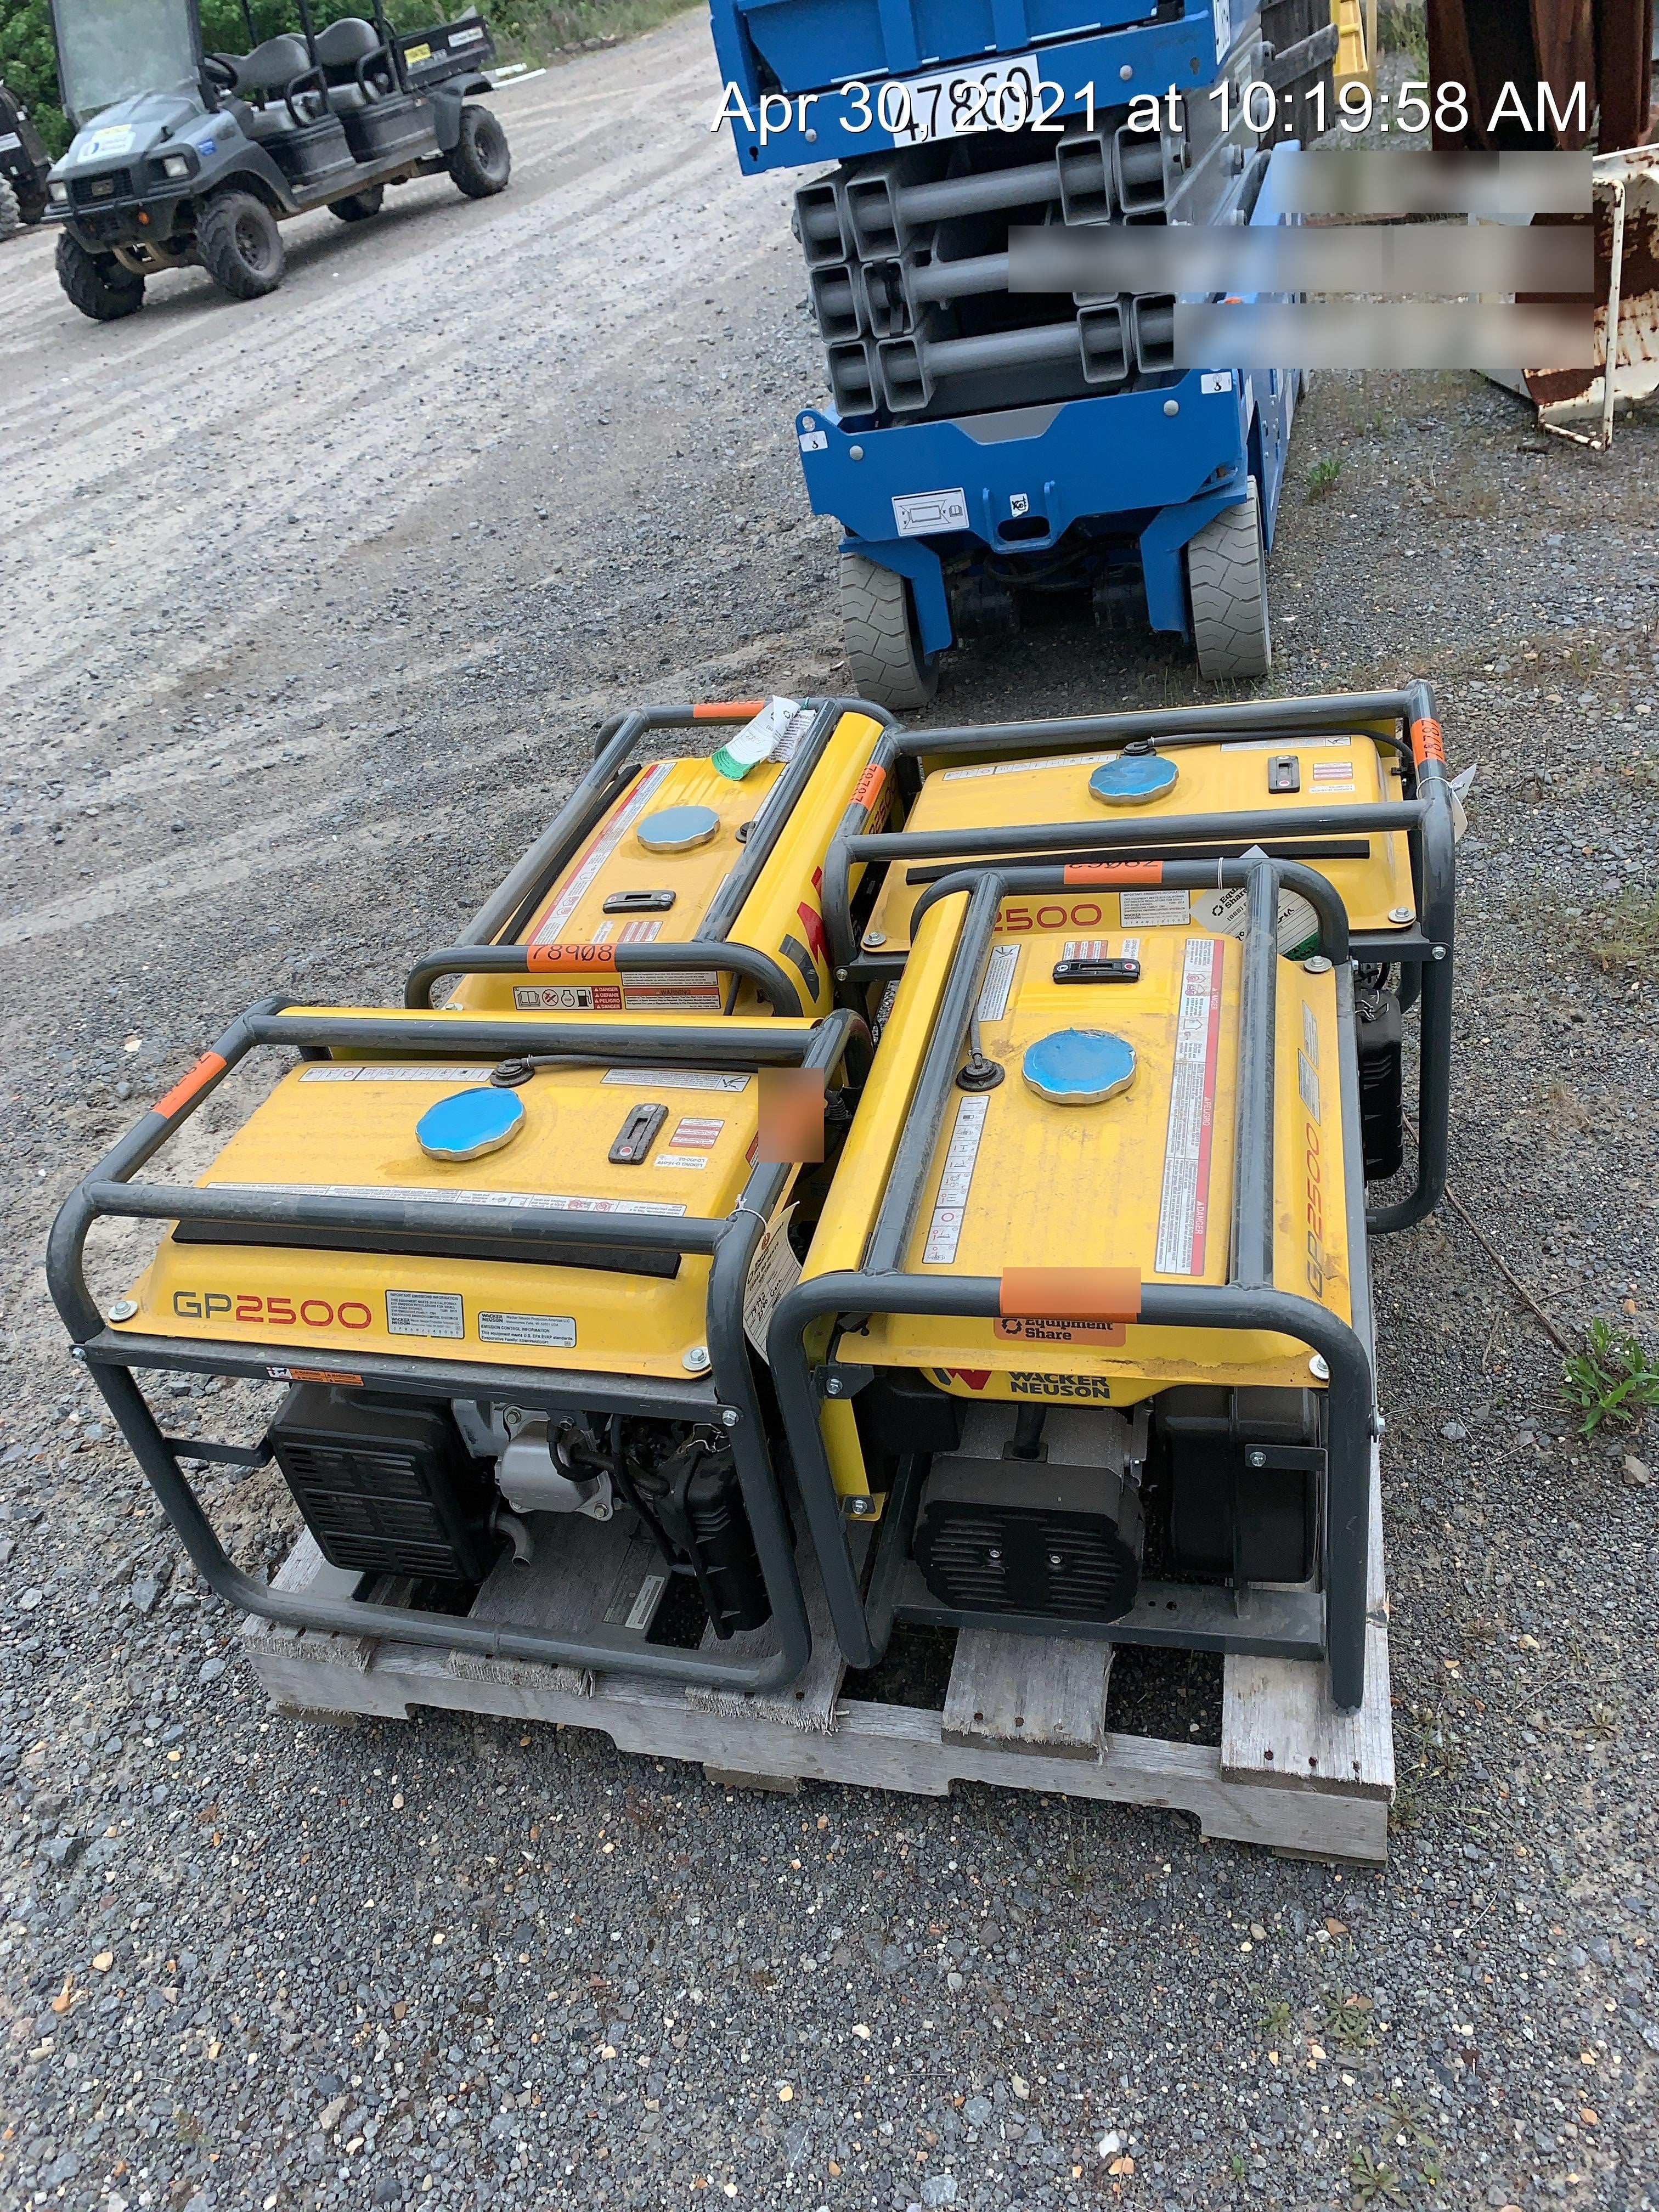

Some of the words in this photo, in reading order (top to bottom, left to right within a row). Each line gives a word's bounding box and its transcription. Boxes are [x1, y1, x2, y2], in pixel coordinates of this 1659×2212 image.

[894, 66, 1033, 141] 47869
[1203, 1101, 1211, 1126] PELIGRO
[1195, 1206, 1204, 1234] DANGER
[1306, 1122, 1323, 1298] GP2500
[173, 1291, 372, 1329] GP2500
[1025, 1328, 1072, 1340] Share
[1009, 1371, 1110, 1387] WACKER
[1011, 1381, 1111, 1399] NEUSON
